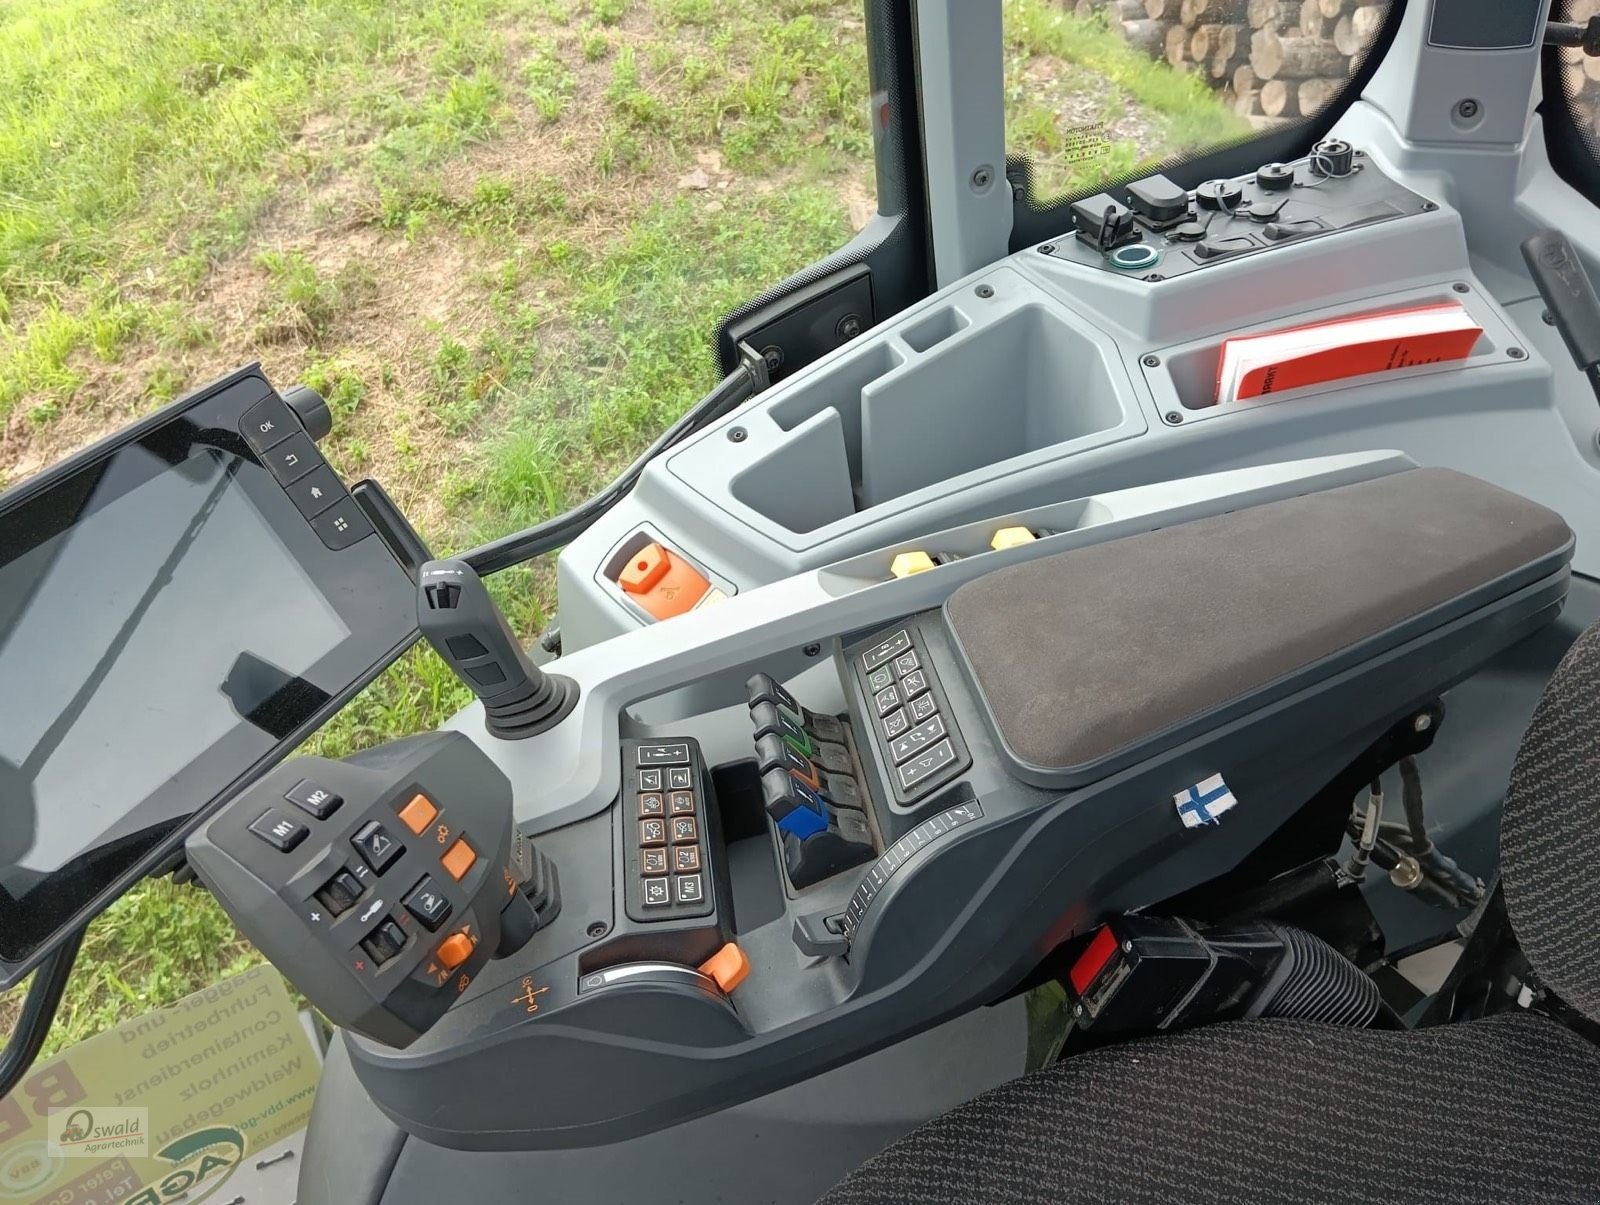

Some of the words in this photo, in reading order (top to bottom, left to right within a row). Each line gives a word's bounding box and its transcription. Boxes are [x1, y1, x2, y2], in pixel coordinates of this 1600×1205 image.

[260, 420, 275, 433] OK
[306, 790, 329, 806] M2
[272, 820, 294, 837] M1
[684, 881, 694, 894] M3
